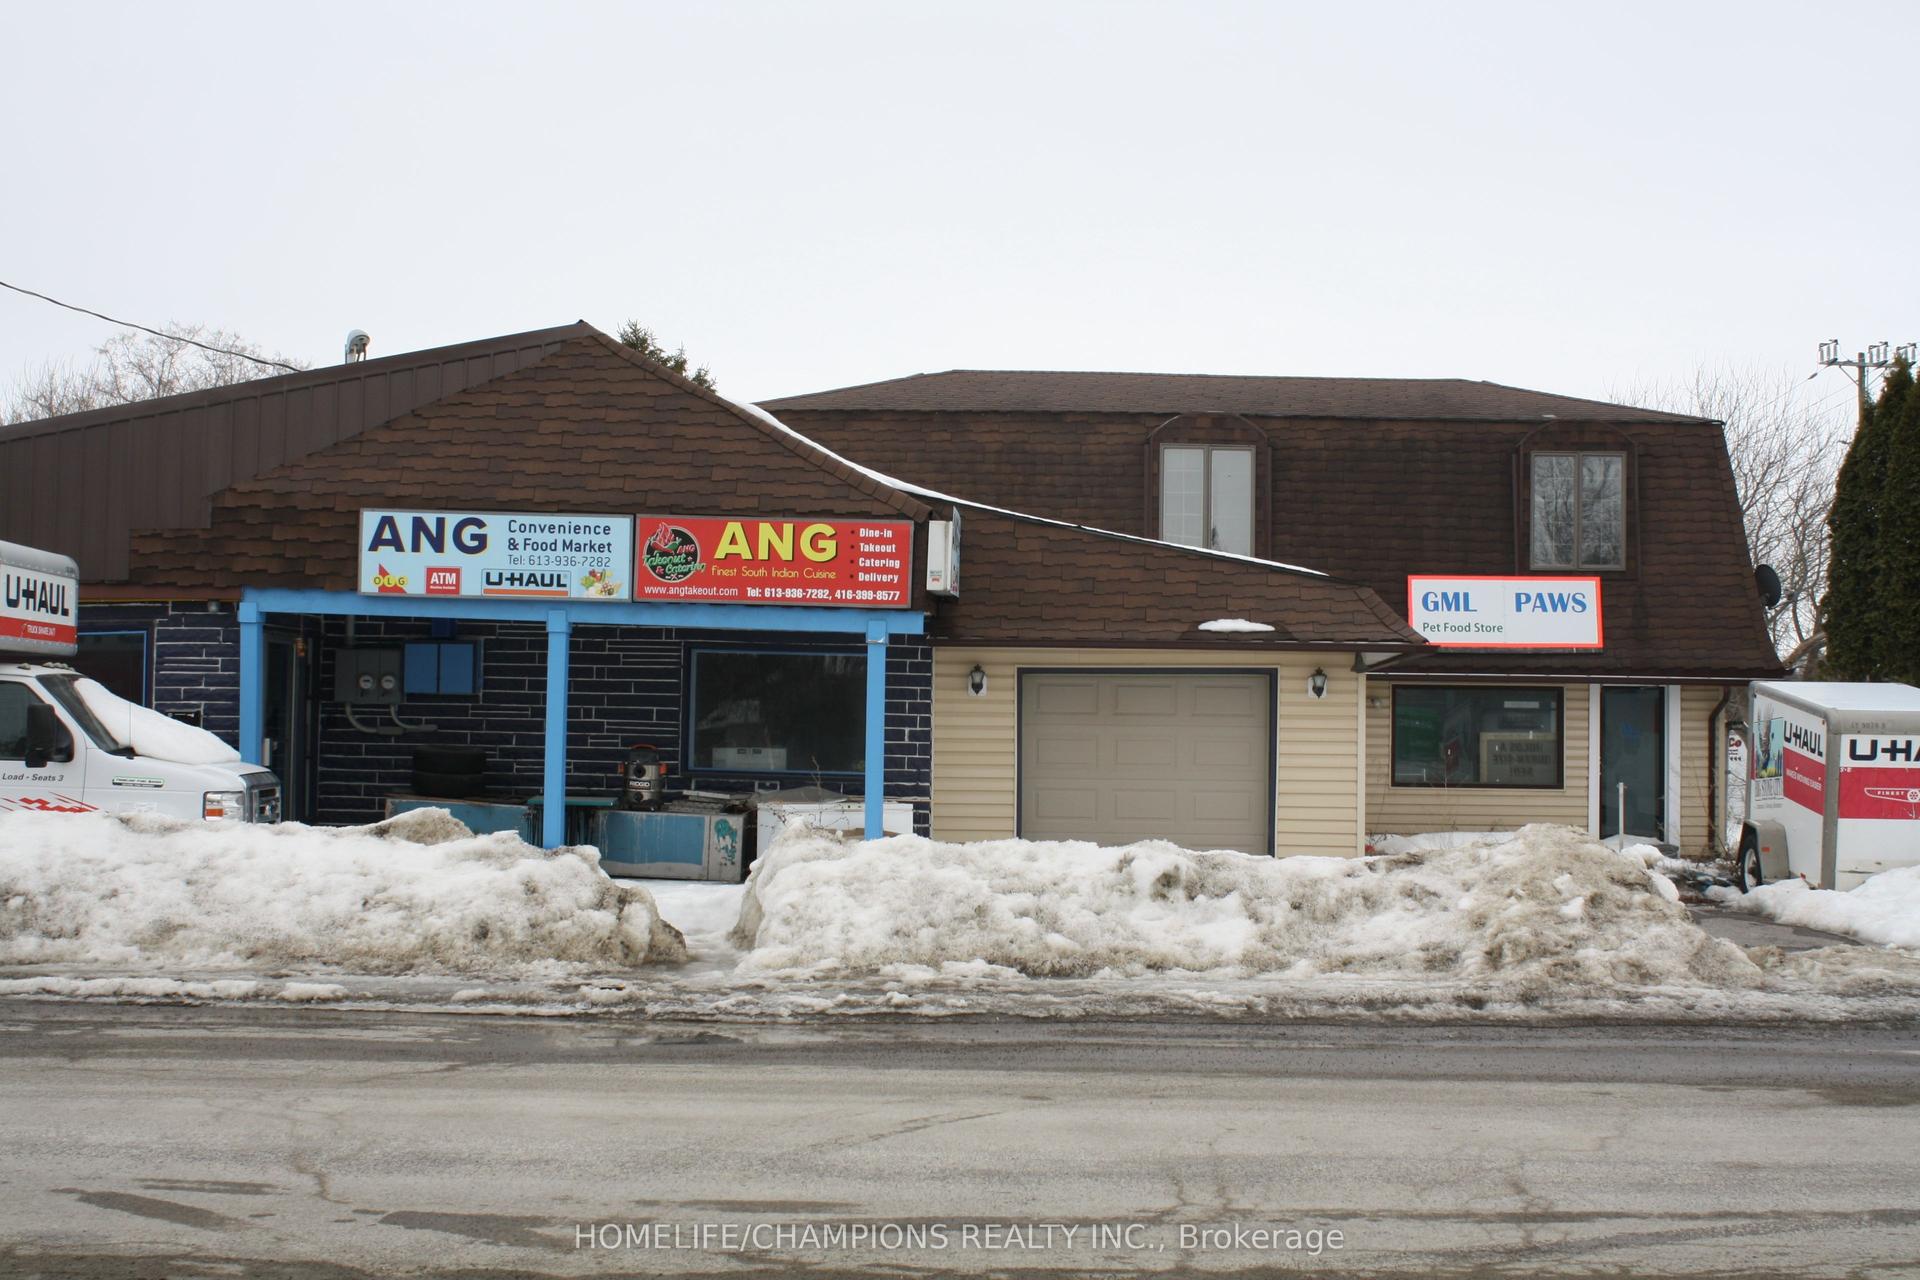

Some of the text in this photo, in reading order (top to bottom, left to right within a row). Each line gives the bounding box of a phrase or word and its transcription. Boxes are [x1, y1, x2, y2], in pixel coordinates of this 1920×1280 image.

[508, 519, 611, 536] Convenience
[859, 527, 893, 538] Dine-in
[367, 515, 490, 555] ANG
[713, 521, 837, 562] ANG
[507, 537, 612, 553] & Food Market
[859, 542, 896, 553] Takeout
[507, 554, 611, 568] Tel: 613-936-7282
[858, 557, 901, 569] Catering
[430, 572, 457, 585] ATM
[711, 565, 836, 579] Finest South Indian Cuisine
[858, 572, 899, 584] Delivery
[485, 571, 567, 588] U-HAUL
[6, 574, 69, 617] U-HAUL
[644, 585, 738, 597] www.angtakeout.com
[746, 587, 900, 601] Tel: 613-936-7282, 416-399-8577
[1421, 591, 1587, 613] GML PAWS
[1422, 622, 1504, 633] Pet Food Store
[1783, 721, 1823, 757] U-HAUL
[1849, 739, 1920, 762] U-H
[2, 772, 24, 781] Load
[32, 773, 56, 782] Seats
[58, 774, 65, 782] 3
